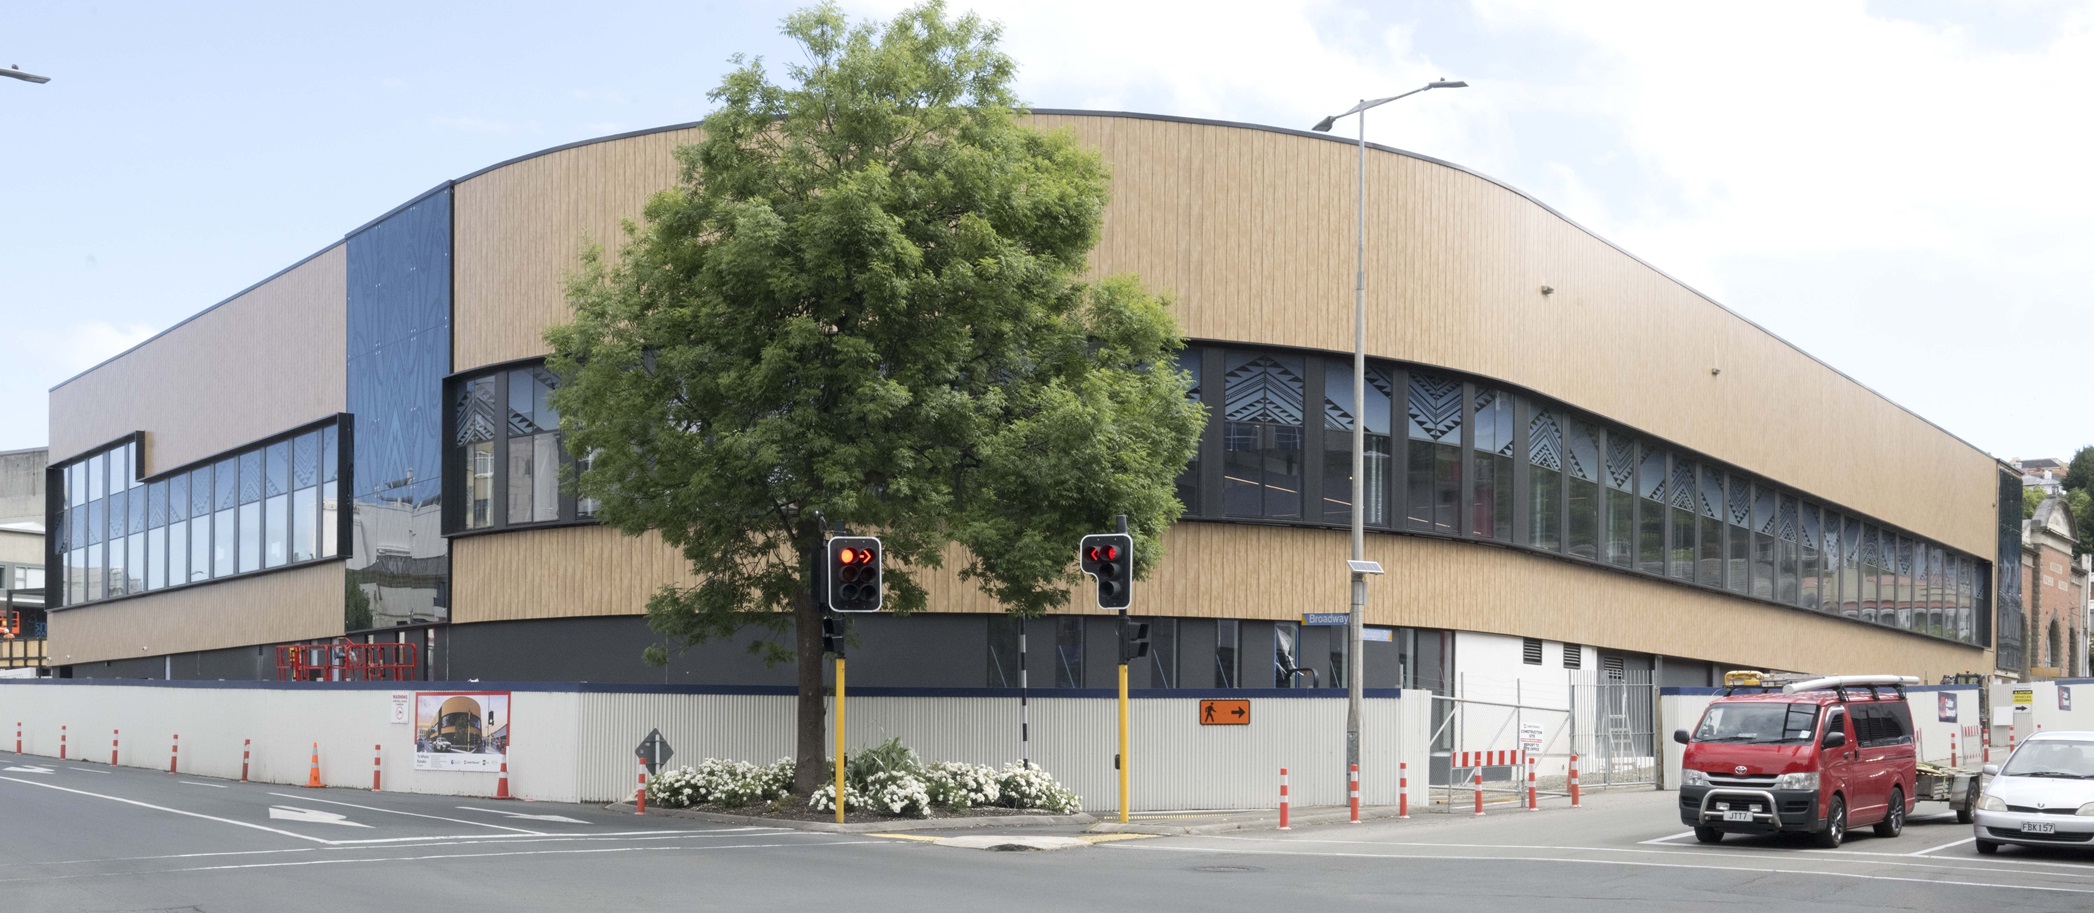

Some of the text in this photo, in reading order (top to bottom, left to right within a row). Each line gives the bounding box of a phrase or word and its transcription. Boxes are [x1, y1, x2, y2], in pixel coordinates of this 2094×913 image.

[1309, 613, 1349, 624] Broadway
[1729, 812, 1748, 820] JTT7
[2022, 823, 2054, 832] FBK157
